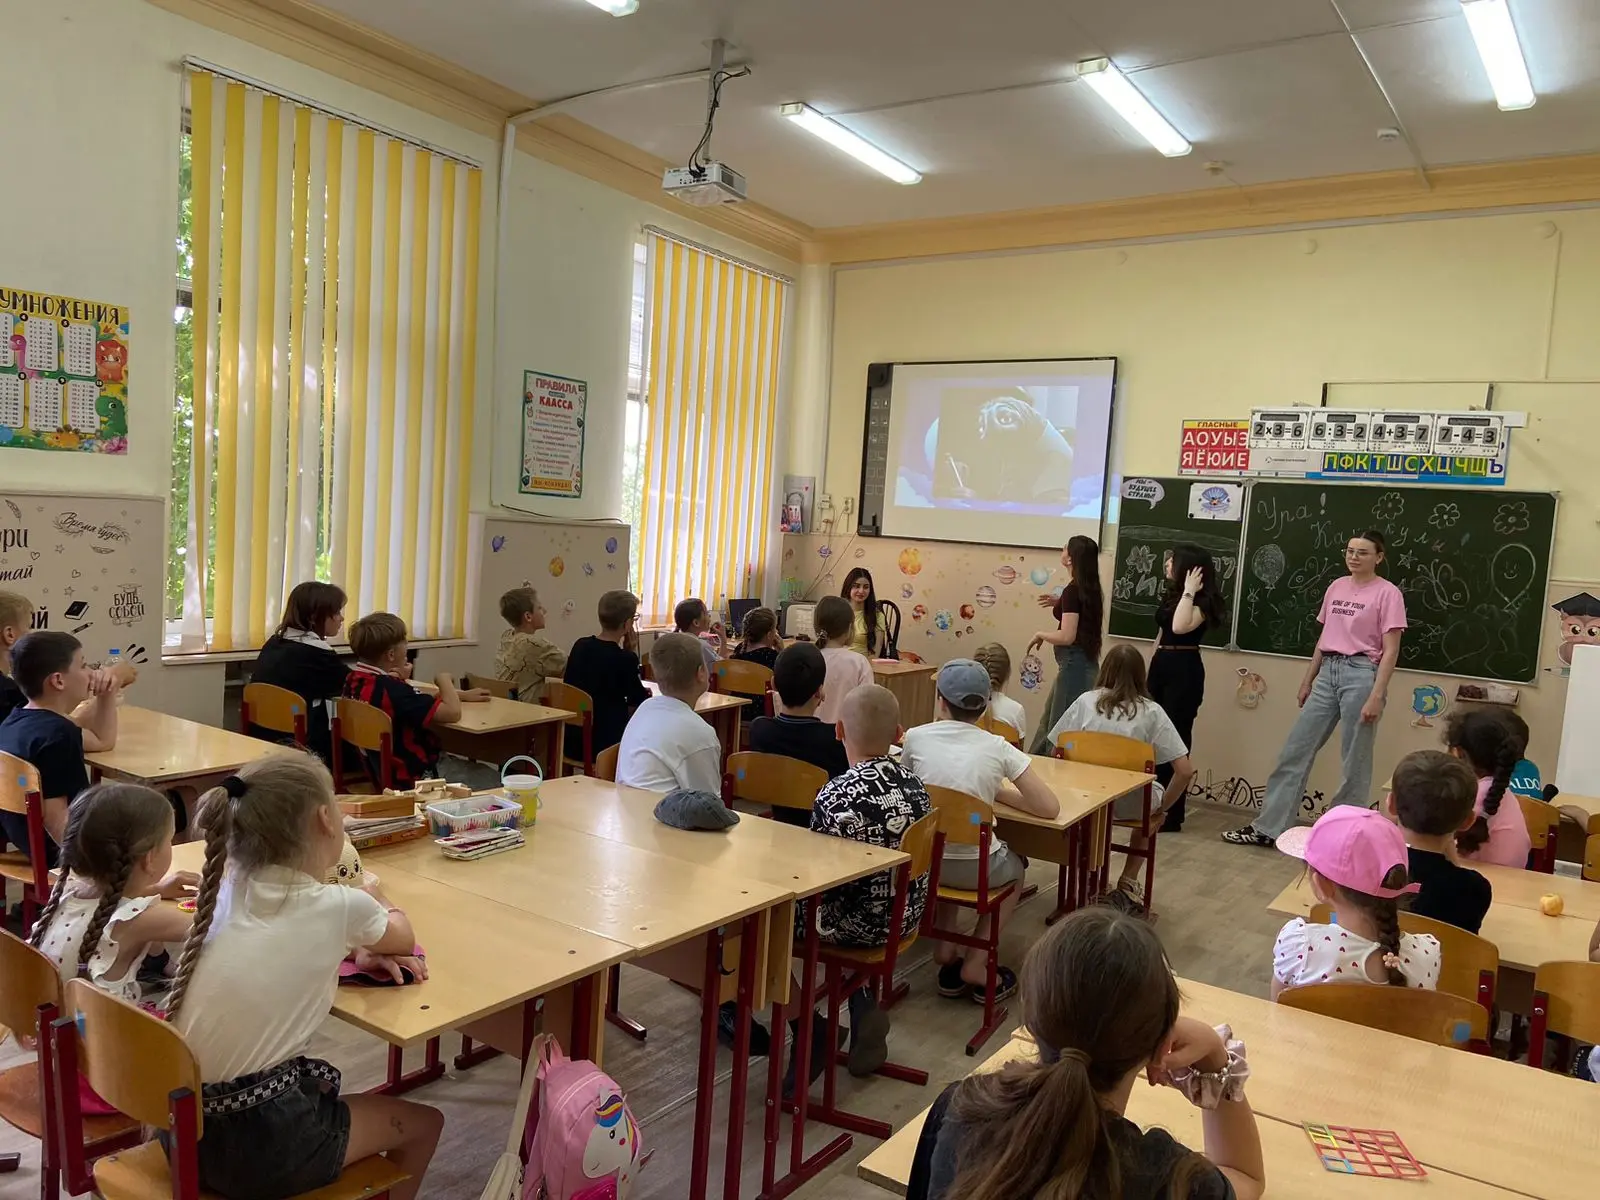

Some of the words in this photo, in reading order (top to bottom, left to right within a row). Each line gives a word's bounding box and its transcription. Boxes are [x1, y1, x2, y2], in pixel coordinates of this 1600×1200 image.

[0, 289, 118, 325] УМНОЖЕНИЯ
[536, 378, 577, 395] ПРАВИЛА
[540, 396, 573, 410] КЛАССА
[114, 592, 139, 606] БУДЬ
